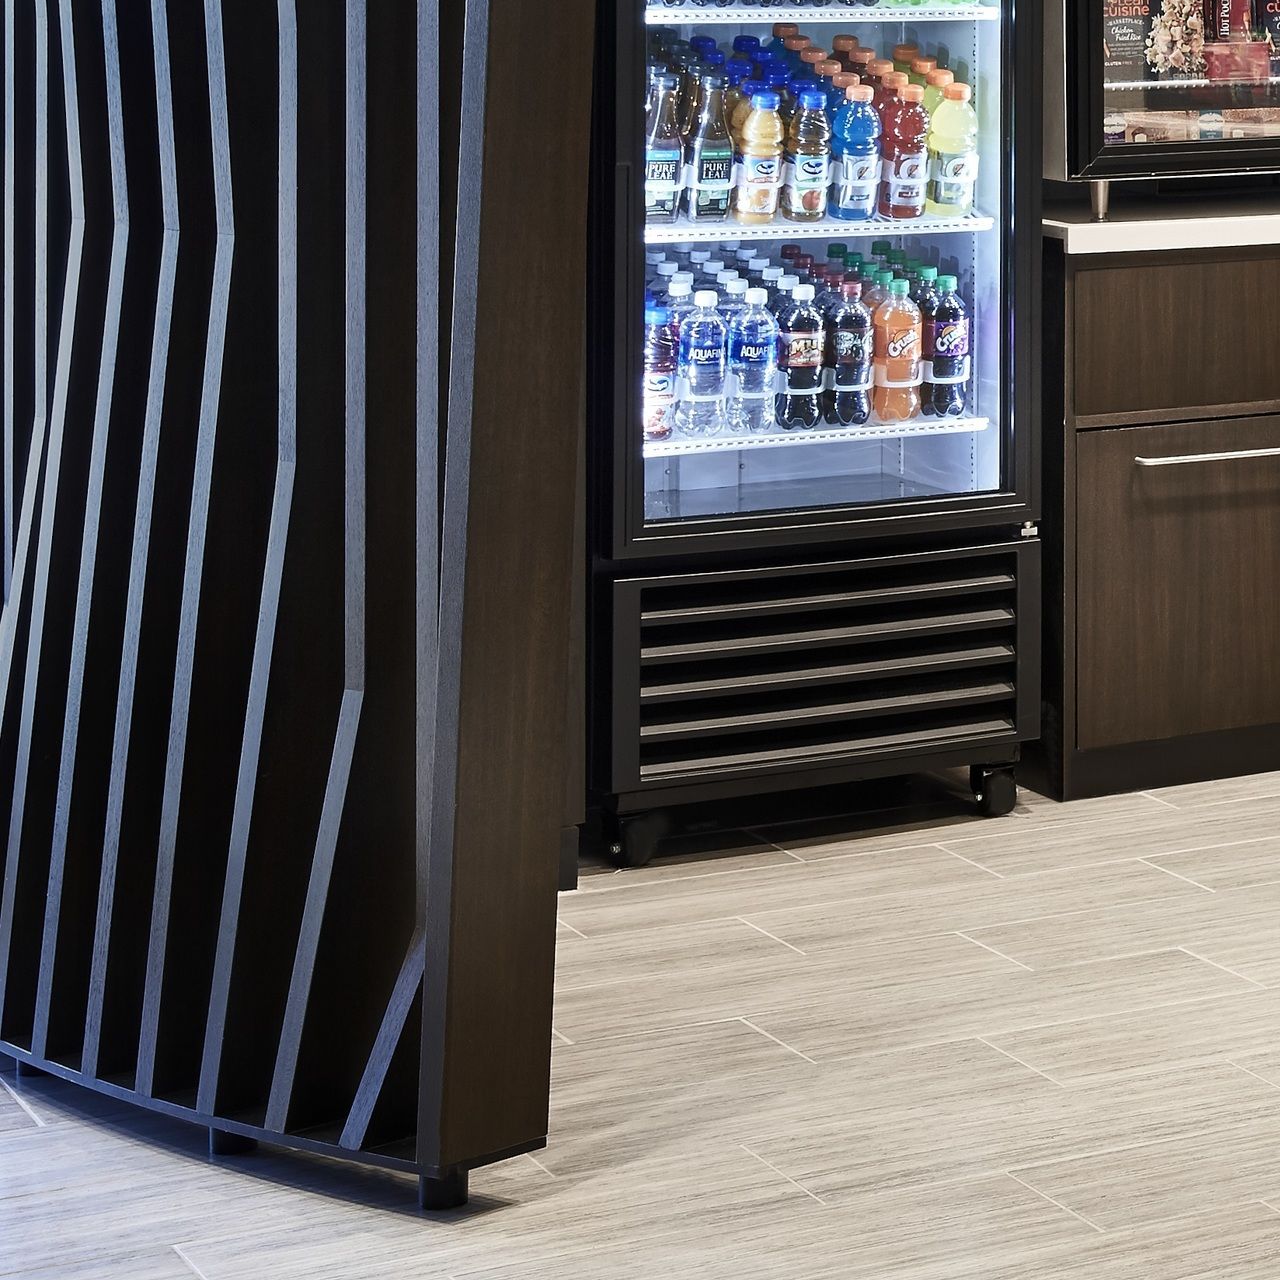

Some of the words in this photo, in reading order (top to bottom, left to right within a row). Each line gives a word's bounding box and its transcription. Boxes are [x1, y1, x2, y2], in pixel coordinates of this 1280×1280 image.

[1219, 19, 1231, 37] HOT
[649, 164, 676, 173] PURE
[703, 163, 729, 172] PURE
